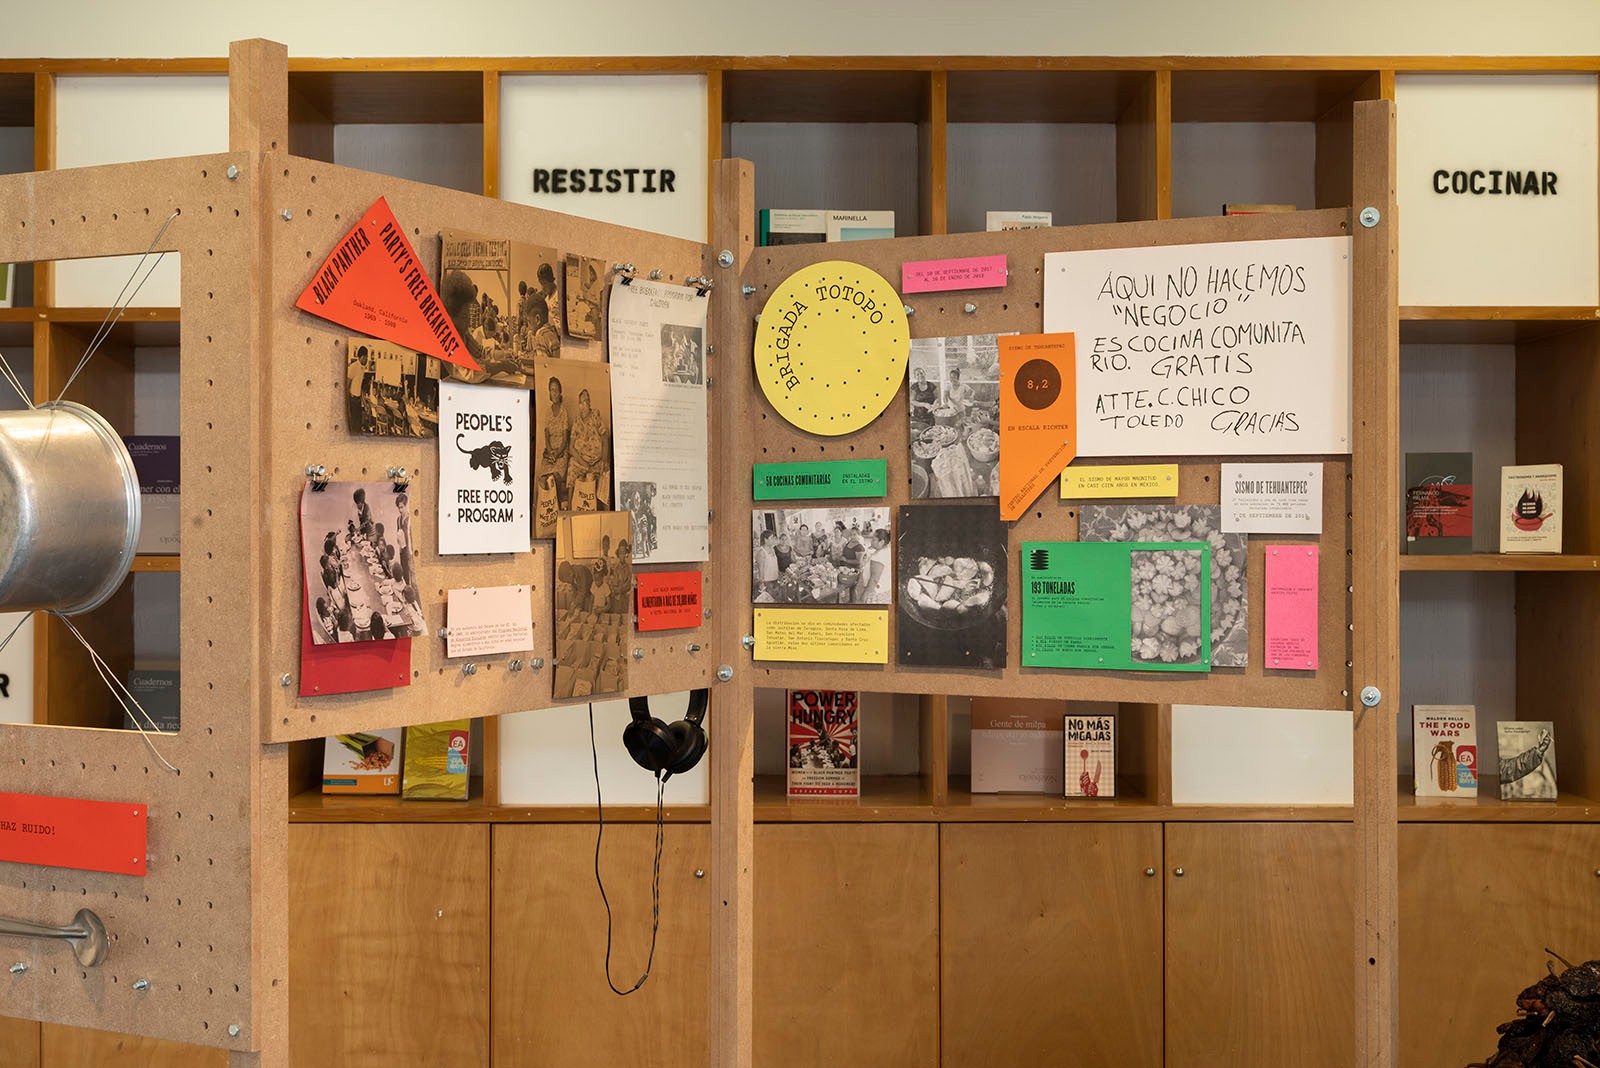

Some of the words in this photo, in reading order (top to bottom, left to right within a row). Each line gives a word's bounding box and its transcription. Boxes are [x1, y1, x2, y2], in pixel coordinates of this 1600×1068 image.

[533, 168, 676, 194] RESISTIR
[1433, 170, 1558, 195] COCINAR
[313, 265, 339, 304] BLACK
[332, 228, 370, 277] PANTHER
[1166, 266, 1198, 300] NO
[1207, 264, 1306, 296] HACEMOS
[379, 222, 412, 273] PARTY'S
[404, 268, 428, 300] FREE
[419, 294, 460, 358] BREAKFAST
[816, 285, 883, 324] TOTOPO
[1112, 294, 1250, 327] "NEGOCIO"
[1128, 328, 1204, 352] COCINA
[1211, 321, 1306, 348] COMUNITA
[776, 300, 808, 391] BRIGADA
[1090, 354, 1131, 372] RIO.
[1150, 350, 1253, 378] GRATIS
[1027, 379, 1048, 390] 8,2
[456, 413, 512, 432] PEOPLE'S
[1100, 414, 1184, 430] TOLEDO
[1210, 410, 1300, 436] GRACIAS
[128, 442, 166, 451] Cuadernos
[773, 475, 794, 486] COCINAS
[795, 474, 831, 486] COMUNITARIAS
[1235, 480, 1254, 494] SISMO
[1256, 481, 1264, 494] DE
[1265, 480, 1308, 494] TEHUANTEPEC
[458, 490, 481, 504] FREE
[484, 490, 514, 504] FOOD
[458, 508, 514, 522] PROGRAM
[1031, 581, 1041, 594] 193
[1042, 581, 1075, 594] TONELADAS
[133, 677, 172, 686] Cuadernos
[792, 692, 856, 707] POWER
[792, 709, 856, 724] HUNGRY
[1068, 719, 1084, 730] NO
[1087, 718, 1110, 730] MÁS
[990, 720, 1012, 728] Gente
[1014, 720, 1024, 728] de
[1026, 720, 1047, 729] milpa
[1068, 731, 1111, 741] MIGAJAS
[452, 740, 464, 748] EA
[0, 821, 16, 831] HAZ
[22, 824, 56, 835] RUIDO!
